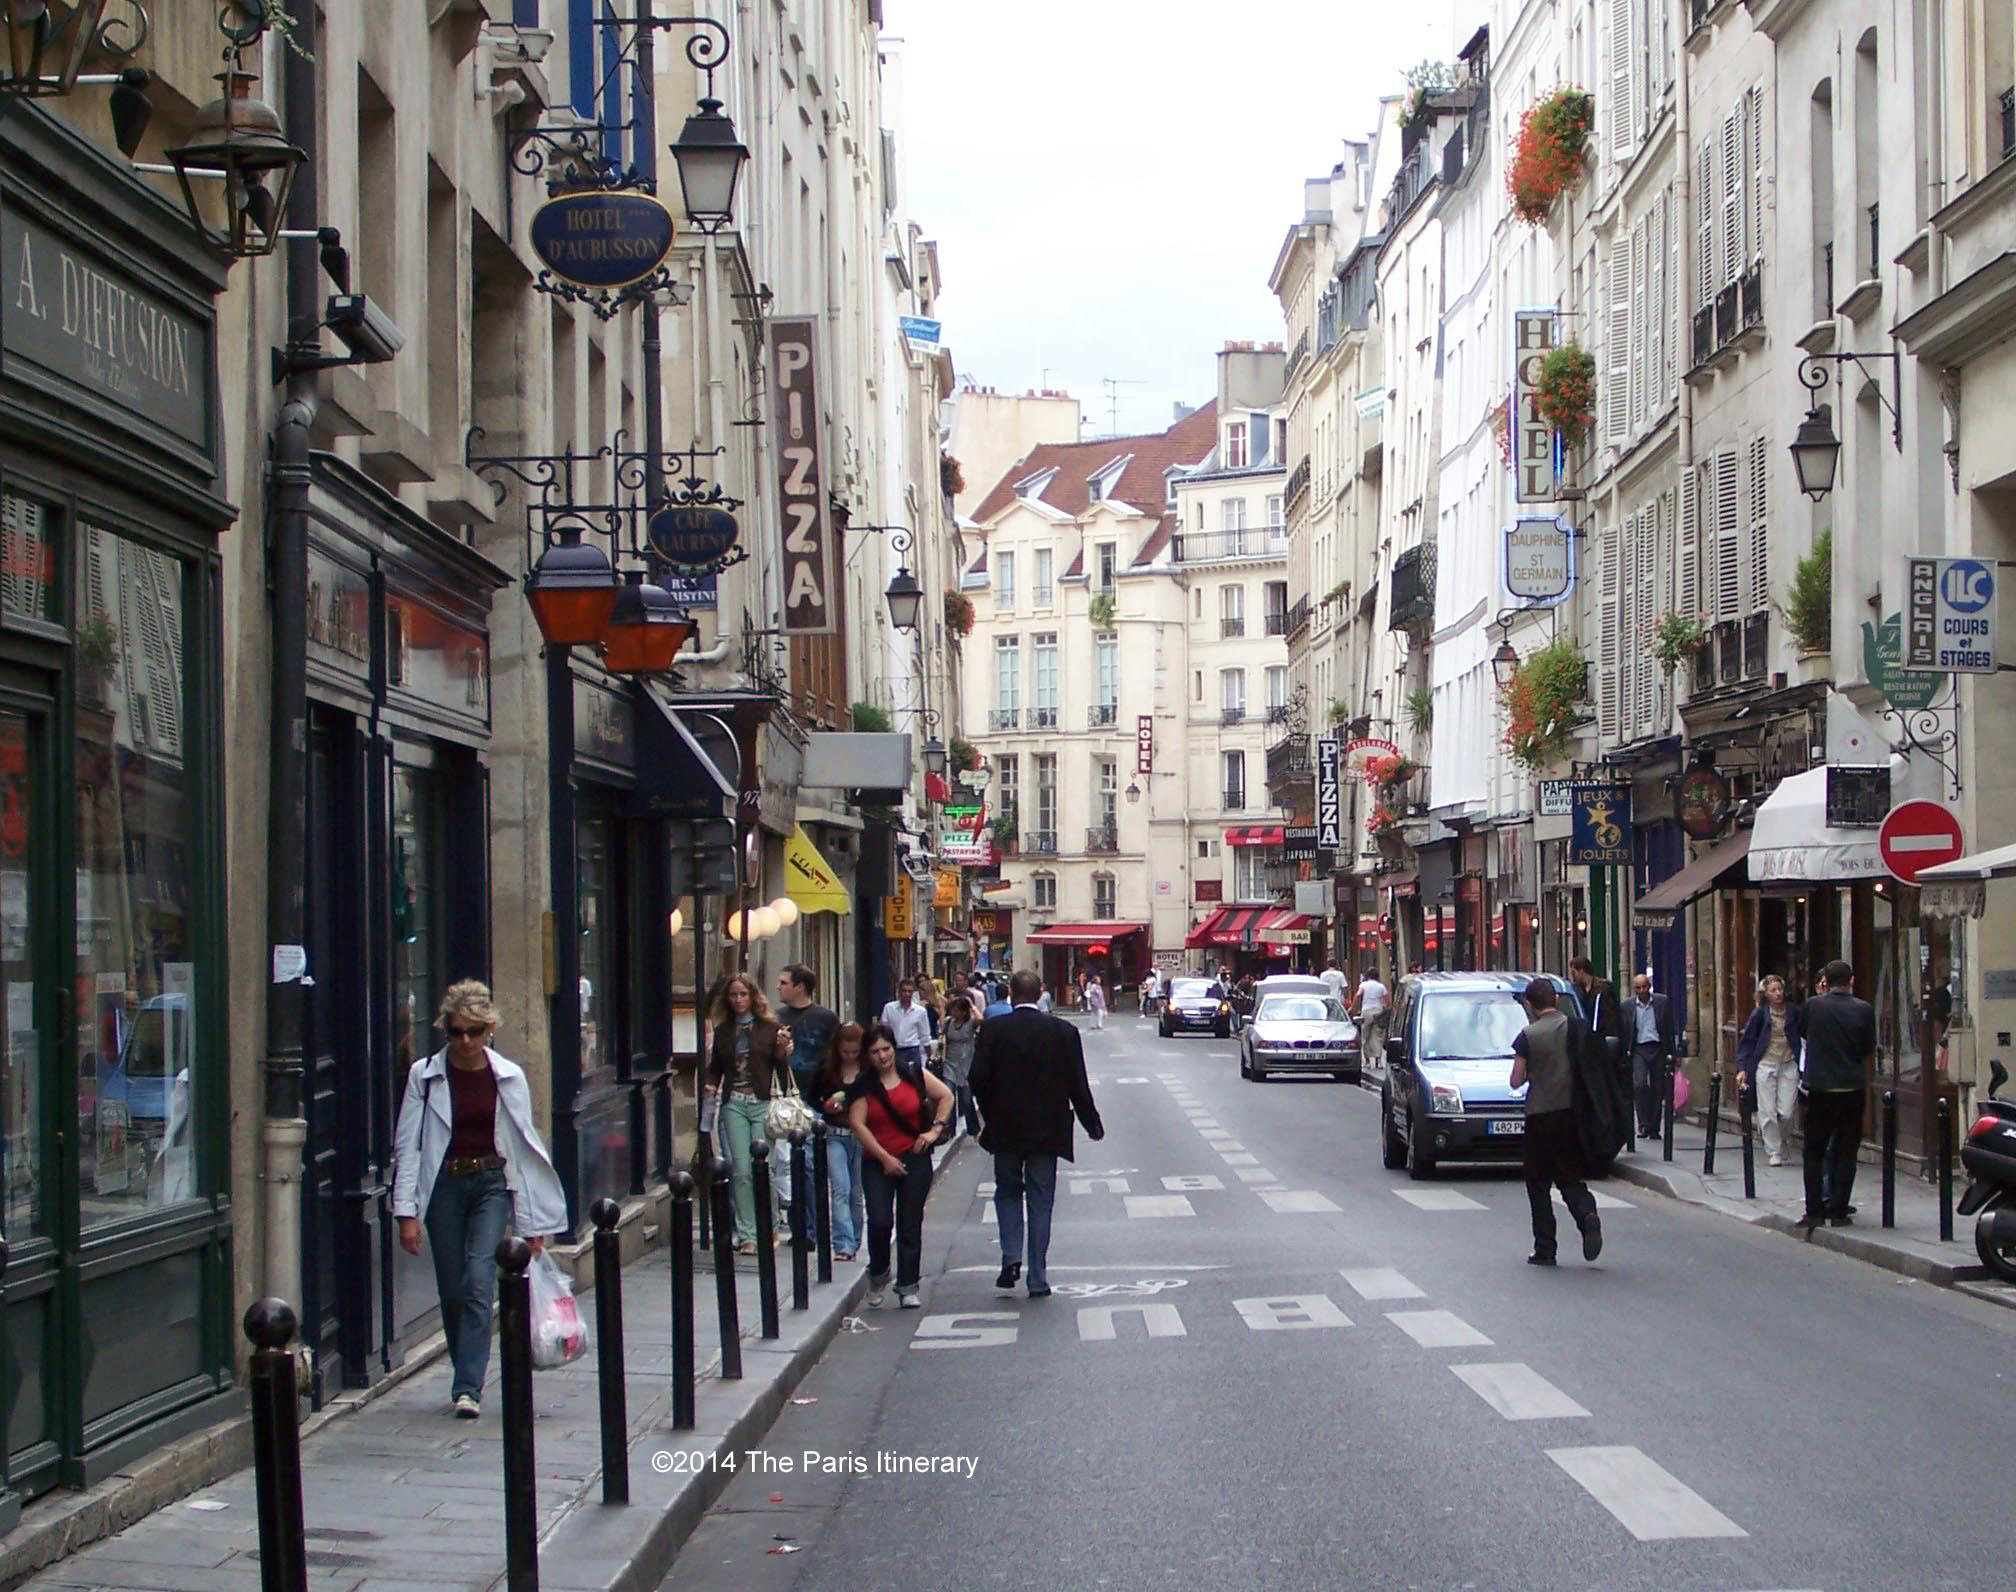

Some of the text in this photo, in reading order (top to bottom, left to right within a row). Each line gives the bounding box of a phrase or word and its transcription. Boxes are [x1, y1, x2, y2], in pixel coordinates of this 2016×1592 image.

[567, 209, 626, 231] HOTEL
[549, 238, 662, 260] D'AUBUSSON
[16, 232, 46, 320] A.
[60, 252, 190, 397] DIFFUSION
[1517, 318, 1553, 496] HOTEL
[777, 341, 824, 608] PIZZA
[1511, 534, 1565, 547] DAUPHINE
[1530, 553, 1545, 566] ST
[1513, 568, 1563, 580] GERMAIN
[1947, 569, 1988, 604] ILC
[1914, 564, 1932, 661] ANGLAIS
[1944, 618, 1989, 635] COURS
[1959, 637, 1972, 648] et
[1941, 650, 1991, 667] STAGES
[1140, 719, 1151, 770] HOTEL
[1320, 742, 1339, 844] PIZZA
[1577, 790, 1612, 806] JEUX
[1579, 848, 1629, 861] JOUETS
[909, 1294, 1355, 1349] BUS
